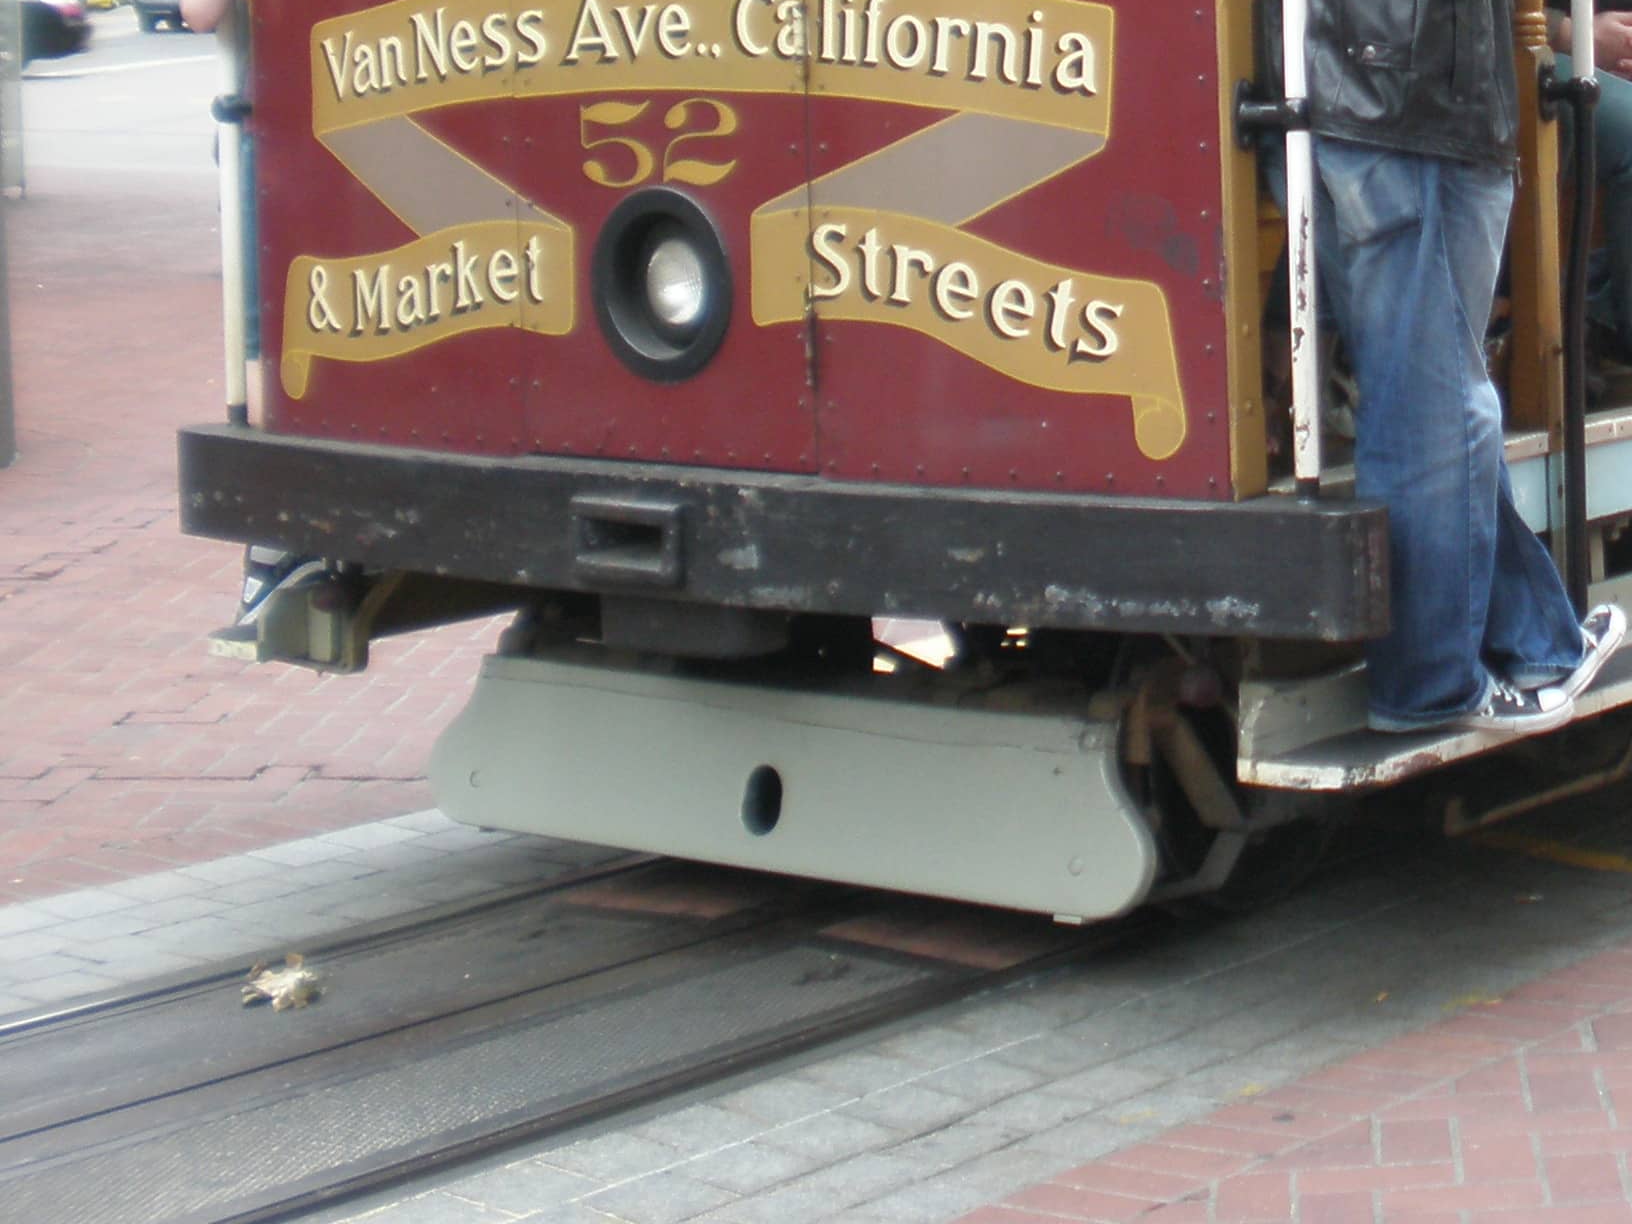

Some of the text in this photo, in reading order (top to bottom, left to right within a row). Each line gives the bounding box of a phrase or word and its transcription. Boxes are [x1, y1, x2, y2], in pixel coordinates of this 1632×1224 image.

[323, 26, 409, 103] Van
[412, 6, 548, 81] Ness
[578, 98, 738, 189] 52
[305, 222, 1125, 362] & Market Streets
